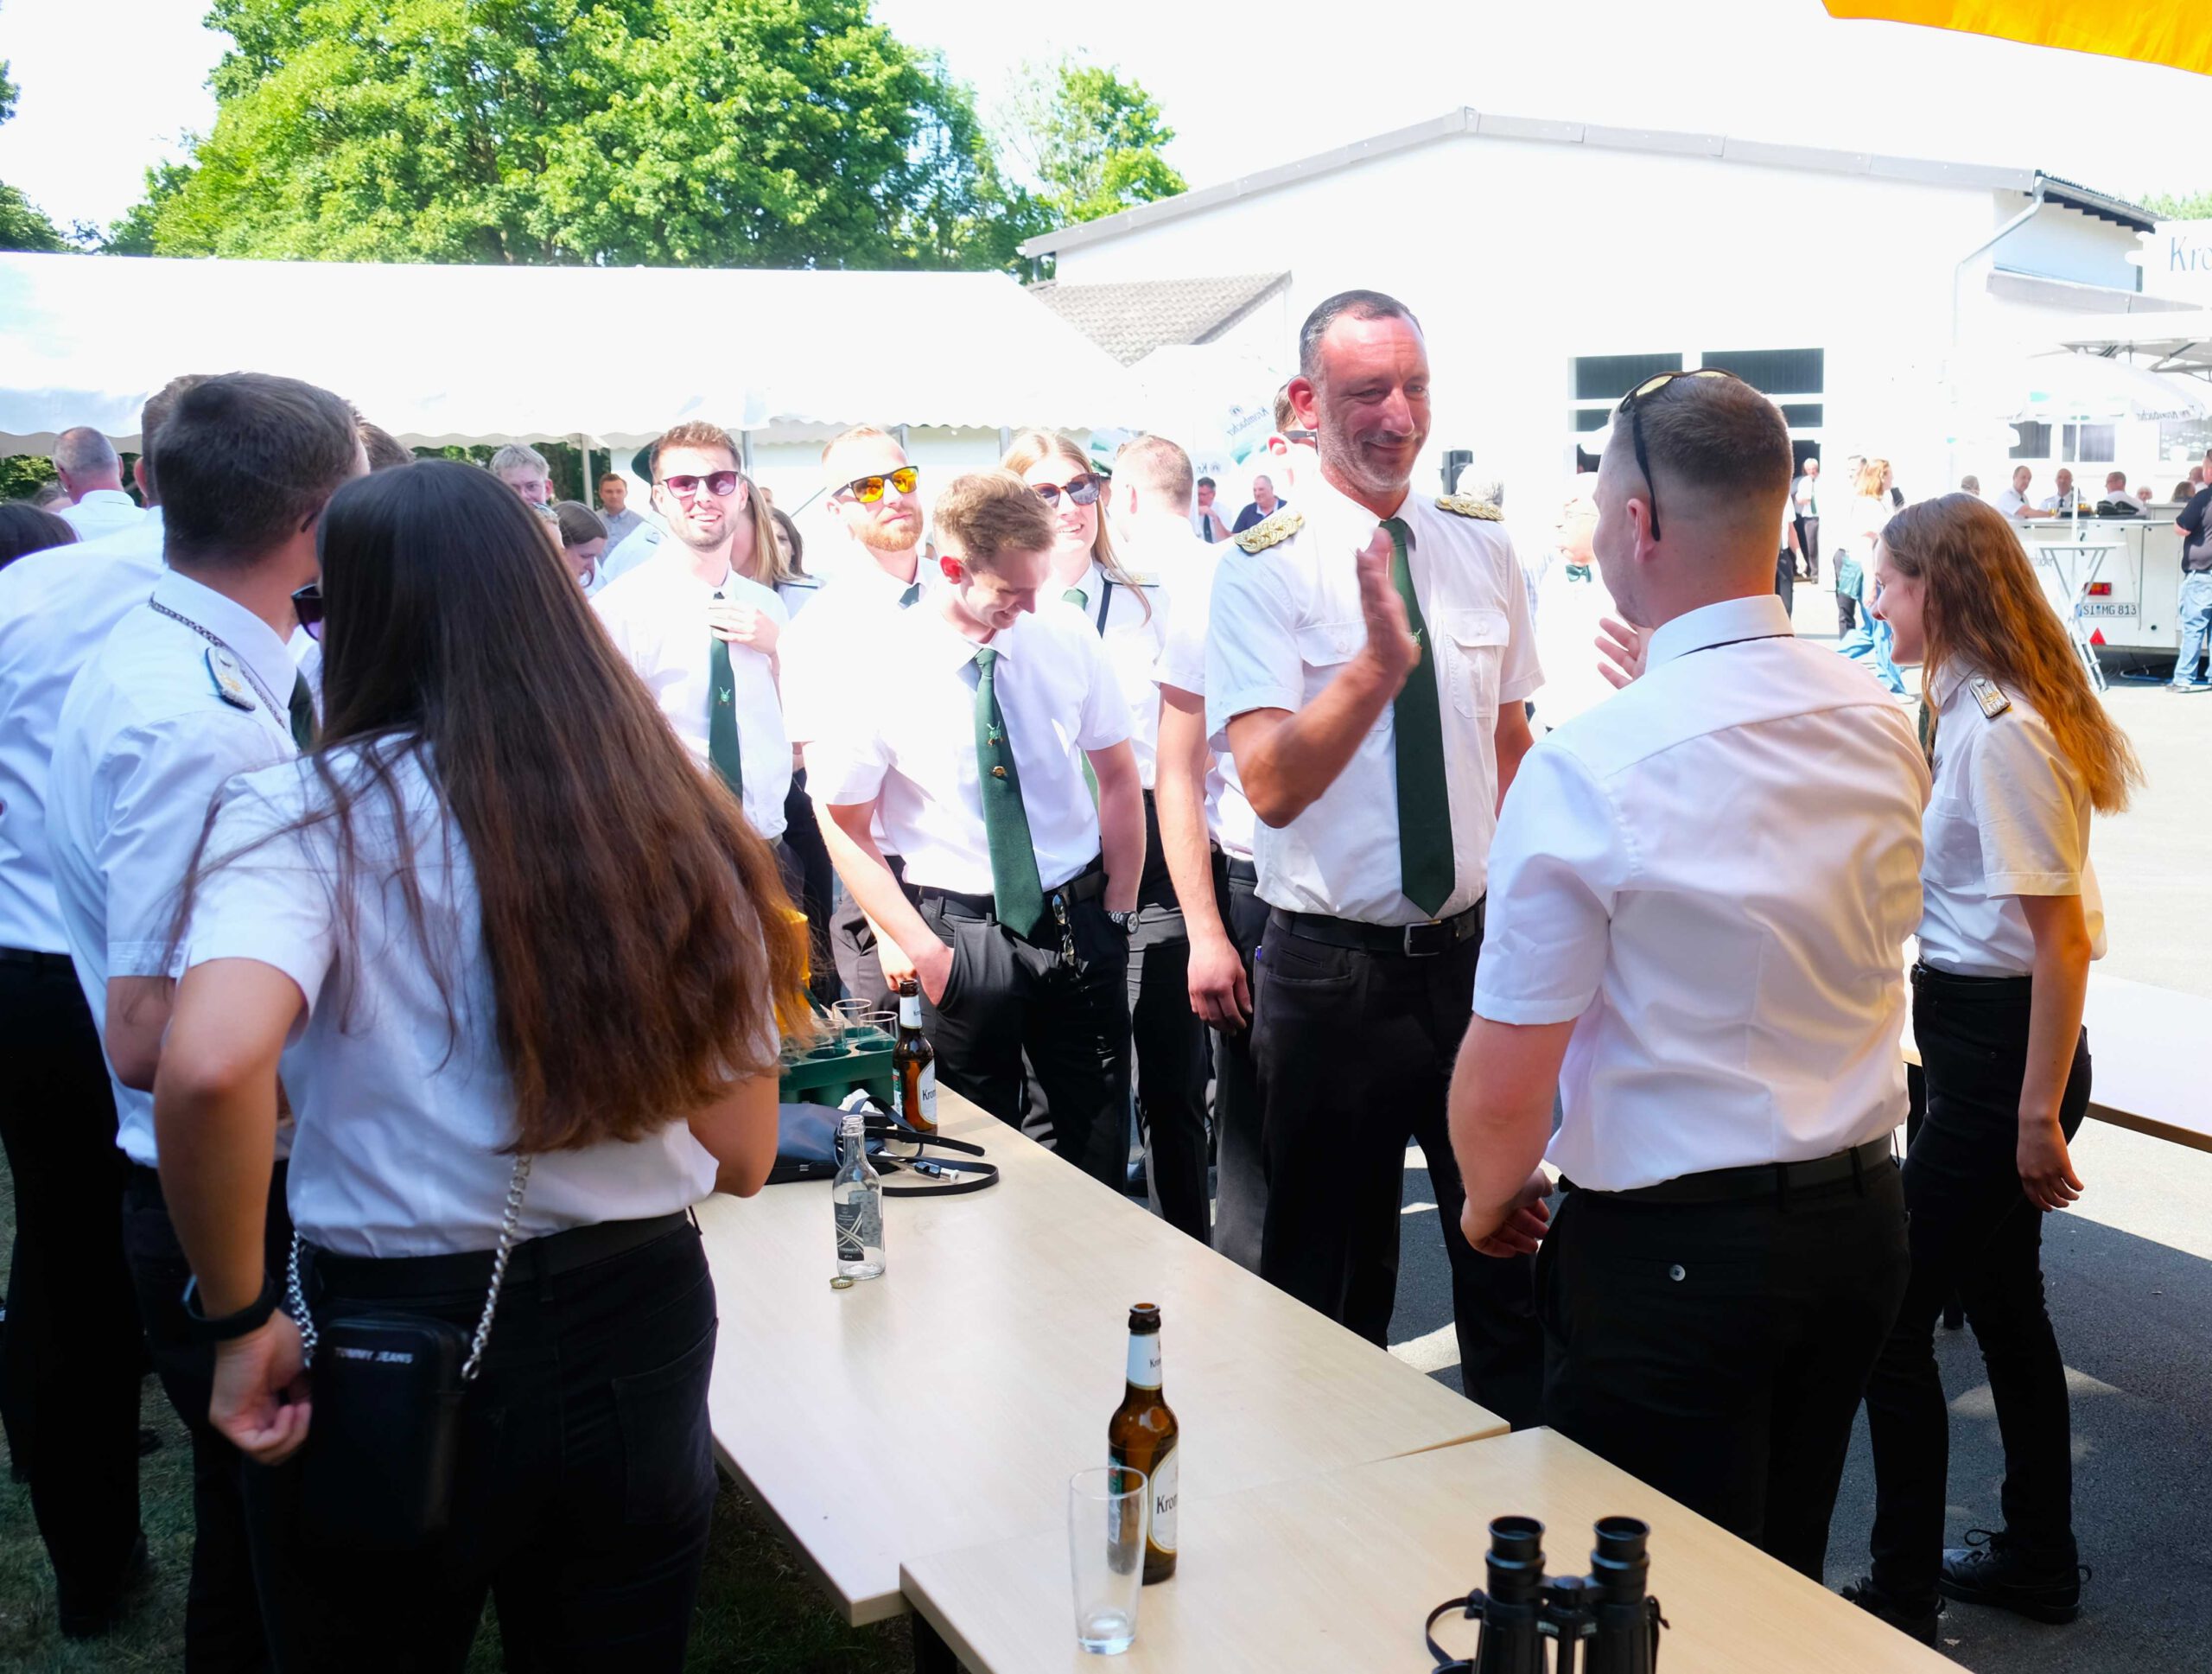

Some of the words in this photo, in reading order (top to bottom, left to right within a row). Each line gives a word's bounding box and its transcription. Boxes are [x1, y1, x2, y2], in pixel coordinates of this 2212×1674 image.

[2118, 605, 2137, 614] 813
[334, 1346, 374, 1361] TOMMY
[375, 1350, 414, 1364] JEANS
